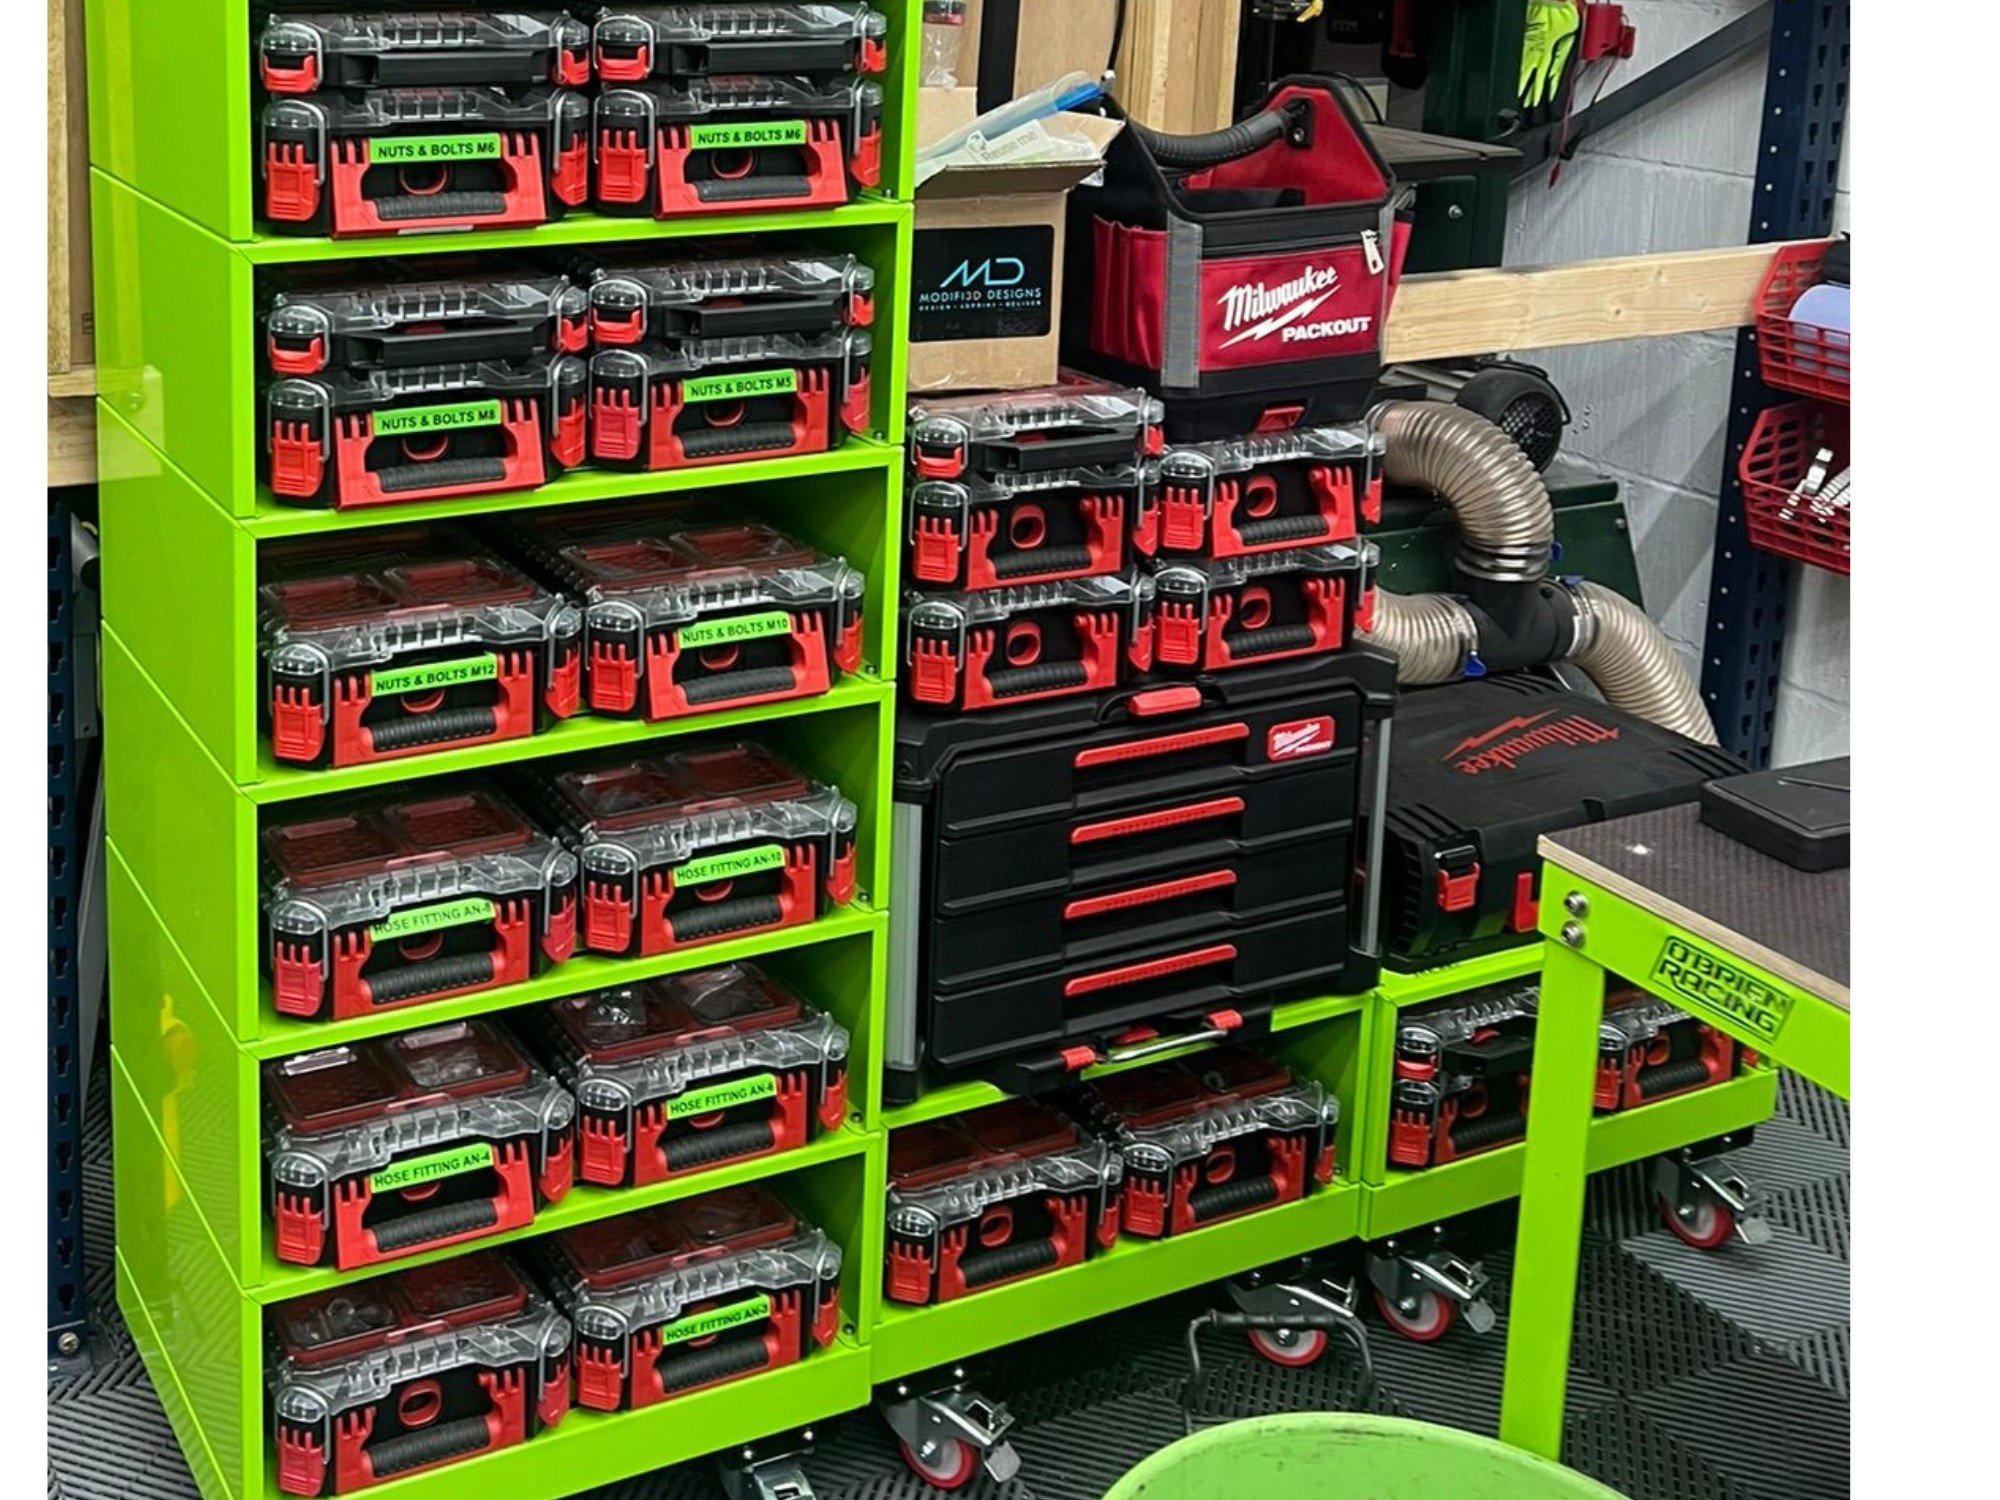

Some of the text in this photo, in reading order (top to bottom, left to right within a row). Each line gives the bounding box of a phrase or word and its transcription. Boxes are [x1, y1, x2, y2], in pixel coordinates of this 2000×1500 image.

[378, 141, 496, 158] NUTS & BOLTS M6
[697, 128, 801, 144] NUTS & BOLTS M6
[987, 287, 1042, 301] DESIGNS
[1216, 265, 1340, 331] Milwaukee
[1281, 316, 1373, 343] PACKOUT
[691, 376, 792, 397] NUTS & BOLTS M5
[381, 416, 417, 431] NUTS
[420, 415, 430, 427] &
[433, 411, 476, 426] BOLTS
[682, 618, 788, 643] NUTS & BOLTS M10
[376, 665, 495, 692] NUTS & BOLTS M12
[1454, 714, 1620, 776] Milwaukee
[676, 850, 781, 881] HOSE FITTING AN-10
[372, 917, 411, 935] HOSE
[413, 908, 461, 928] FITTING
[1658, 958, 1780, 1034] RACING
[670, 1098, 702, 1115] HOSE
[705, 1087, 748, 1107] FITTING
[374, 1150, 490, 1188] HOSE FITTING AN-4
[666, 1324, 698, 1341] HOSE
[700, 1311, 742, 1331] FITTING
